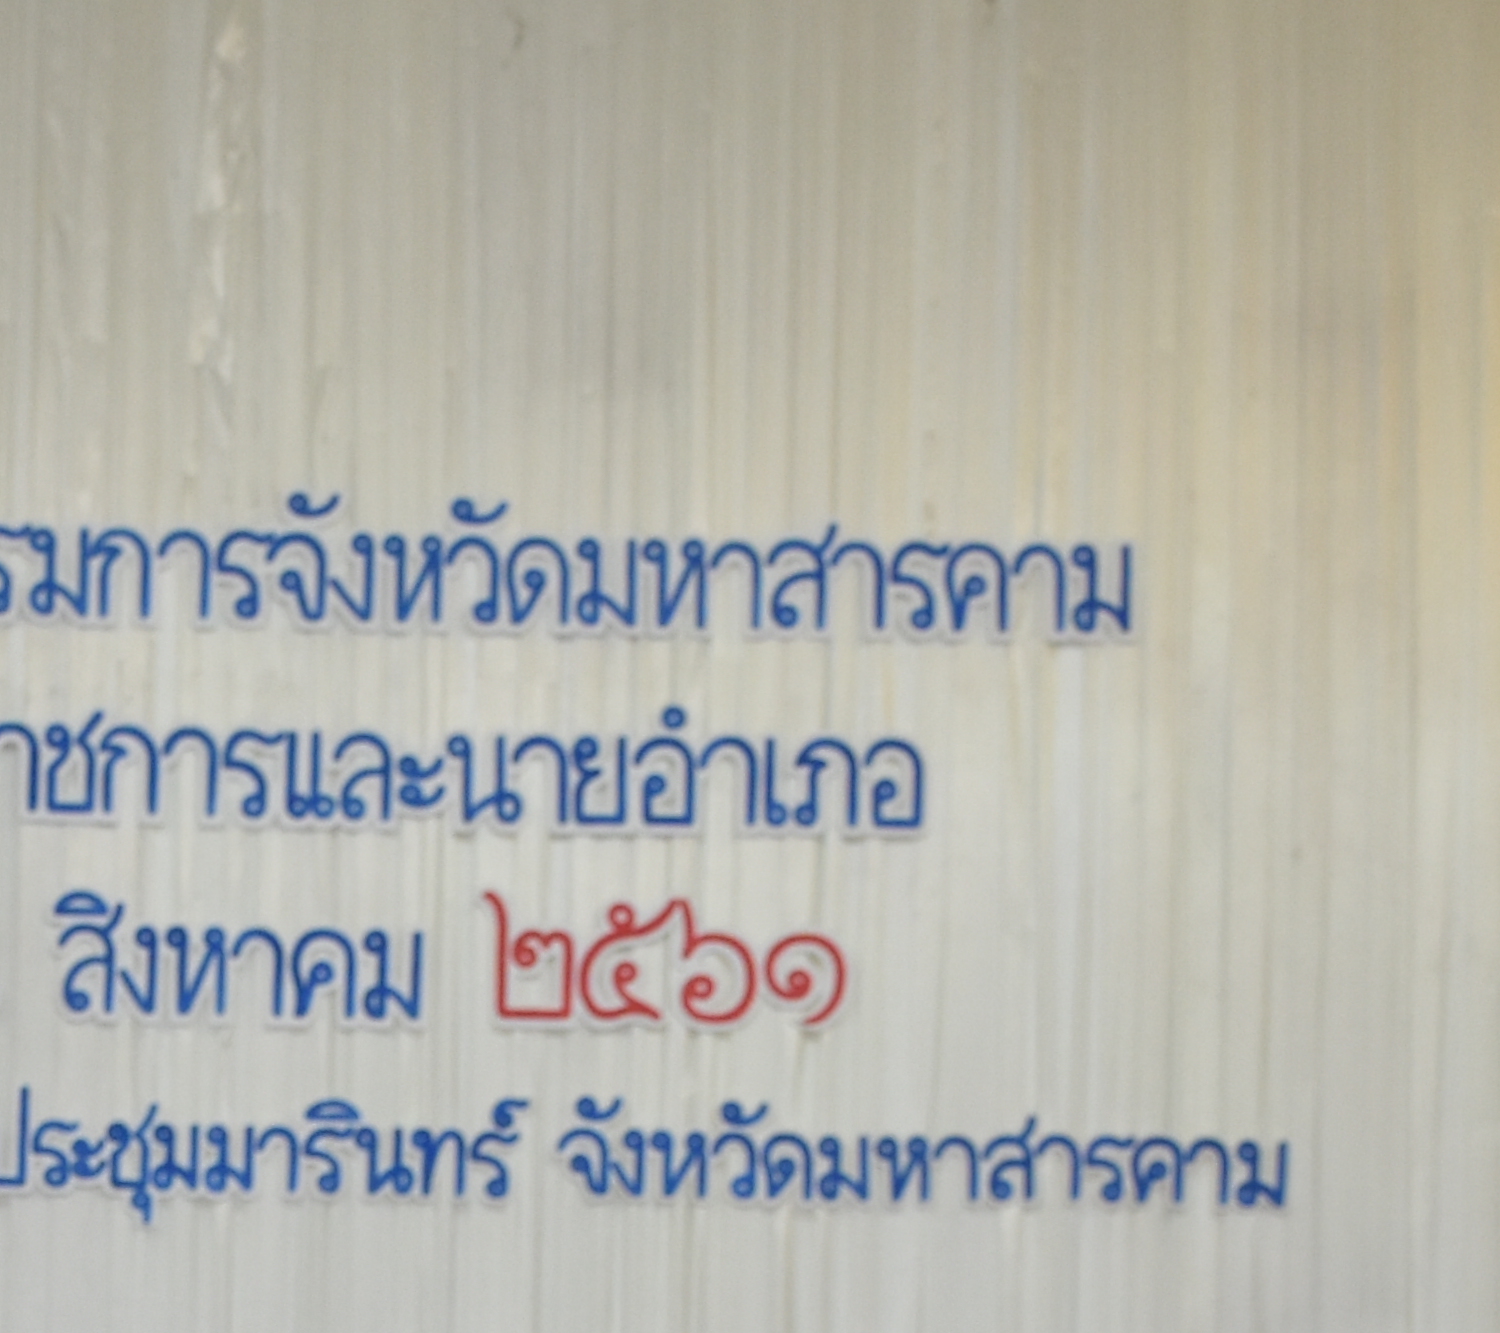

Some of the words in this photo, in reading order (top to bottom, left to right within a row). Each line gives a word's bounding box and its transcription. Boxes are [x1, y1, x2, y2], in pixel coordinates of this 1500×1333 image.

[55, 890, 425, 1020] สิงหาคม
[485, 892, 849, 1025] ๒๕๖๑
[558, 1097, 1290, 1207] จังหวัดมหาสารคาม
